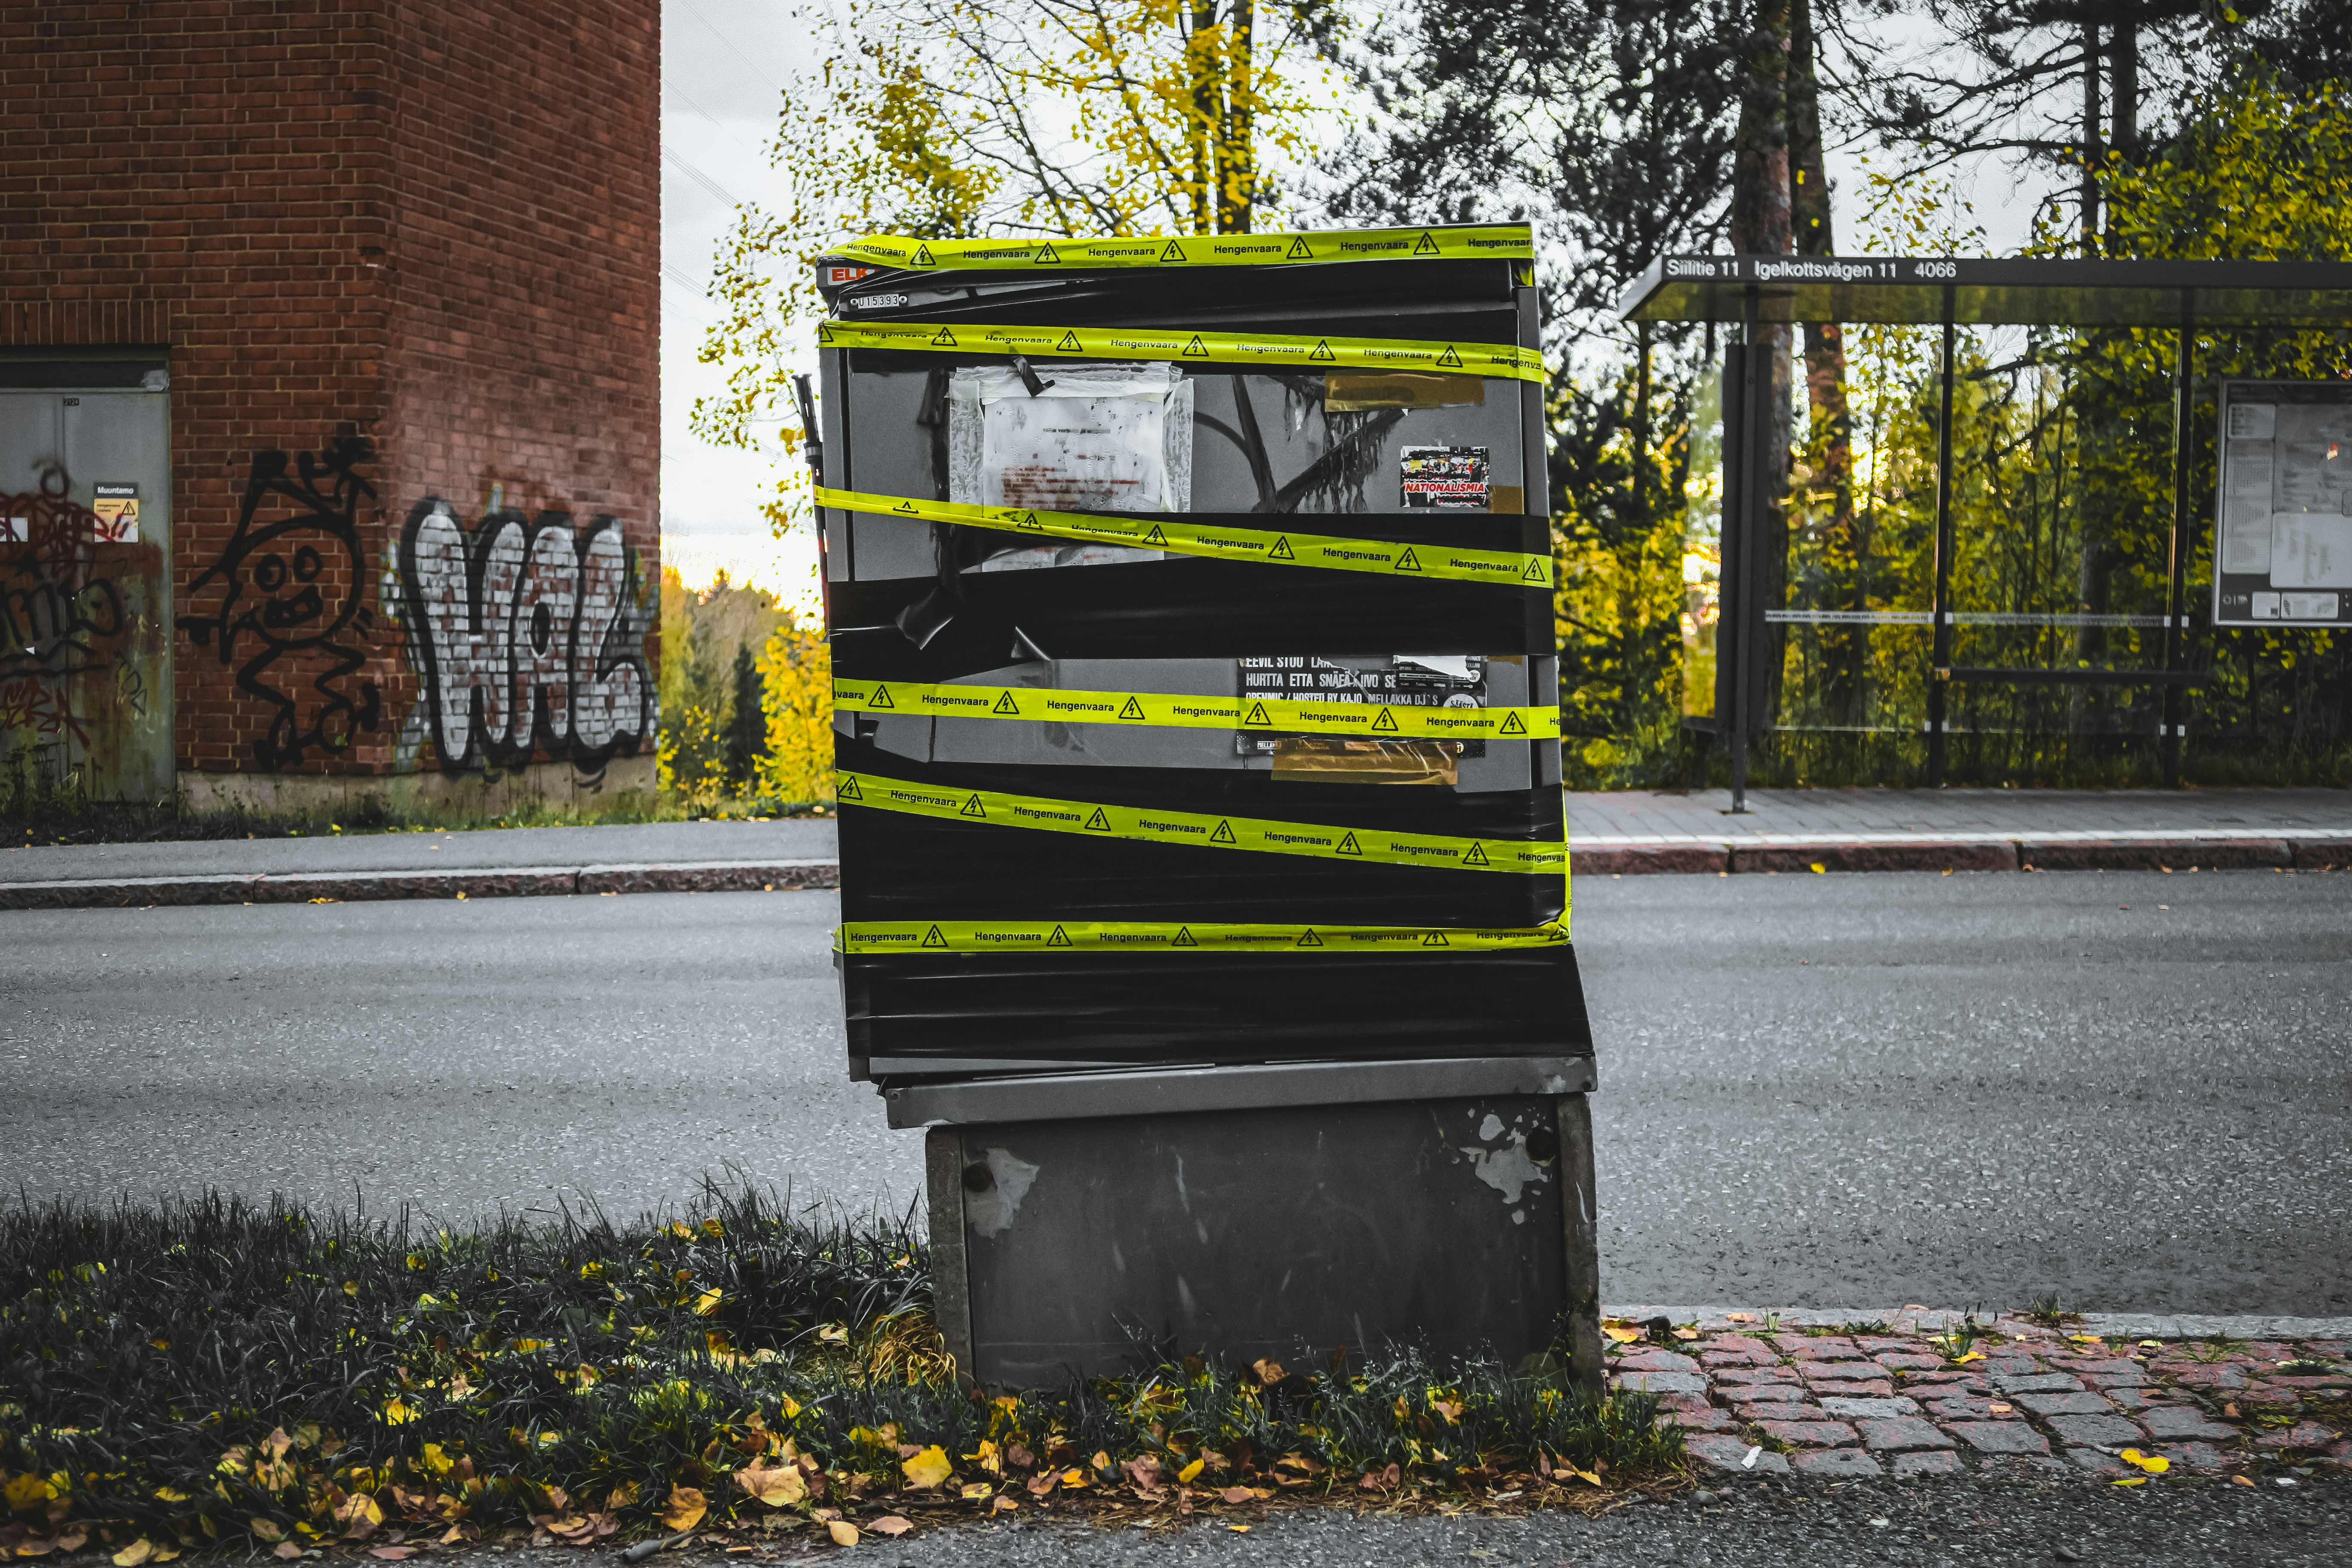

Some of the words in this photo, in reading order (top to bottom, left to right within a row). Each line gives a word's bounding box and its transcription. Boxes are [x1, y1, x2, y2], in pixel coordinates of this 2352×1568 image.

[847, 244, 906, 257] Hengenvaara
[963, 247, 1030, 260] Hengenvaara
[1088, 248, 1155, 258] Hengenvaara
[1214, 245, 1281, 255] Hengenvaara
[1341, 242, 1409, 252] Hengenvaara
[1468, 239, 1532, 249] Hengenvaar
[1666, 259, 1715, 276] Siilitie
[1721, 260, 1739, 276] 11
[1754, 260, 1872, 281] Igelkottsvägen
[1878, 262, 1896, 278] 11
[1914, 261, 1957, 278] 4066
[859, 296, 898, 306] U15393
[986, 333, 1052, 344] Hengenvaara
[1111, 340, 1177, 349] Hengenvaara
[1237, 342, 1304, 354] Hengenvaara
[1364, 349, 1432, 359] Hengenvaara
[1405, 482, 1485, 493] NATIONALISMIA
[1197, 536, 1264, 550] Hengenvaara
[1323, 547, 1390, 562] Hengenvaara
[1450, 558, 1518, 572] Hengenvaara
[1246, 673, 1283, 686] HURTTA
[1290, 673, 1314, 687] ETTA
[1246, 692, 1283, 703] OPENMIC
[1369, 694, 1412, 705] MELLAKKA
[922, 694, 989, 706] Hengenvaara
[1047, 700, 1114, 712] Hengenvaara
[1173, 706, 1240, 717] Hengenvaara
[1299, 711, 1367, 723] Hengenvaara
[1427, 717, 1494, 728] Hengenvaara
[891, 790, 956, 807] Hengenvaara
[1014, 806, 1081, 821] Hengenvaara
[1139, 819, 1206, 834] Hengenvaara
[1264, 831, 1332, 845] Hengenvaara
[1390, 843, 1458, 857] Hengenvaara
[851, 933, 917, 943] Hengenvaara
[975, 932, 1041, 943] Hengenvaara
[1099, 933, 1167, 944] Hengenvaara
[1225, 934, 1292, 943] Hengenvaara
[1351, 932, 1418, 942] Hengenvaara
